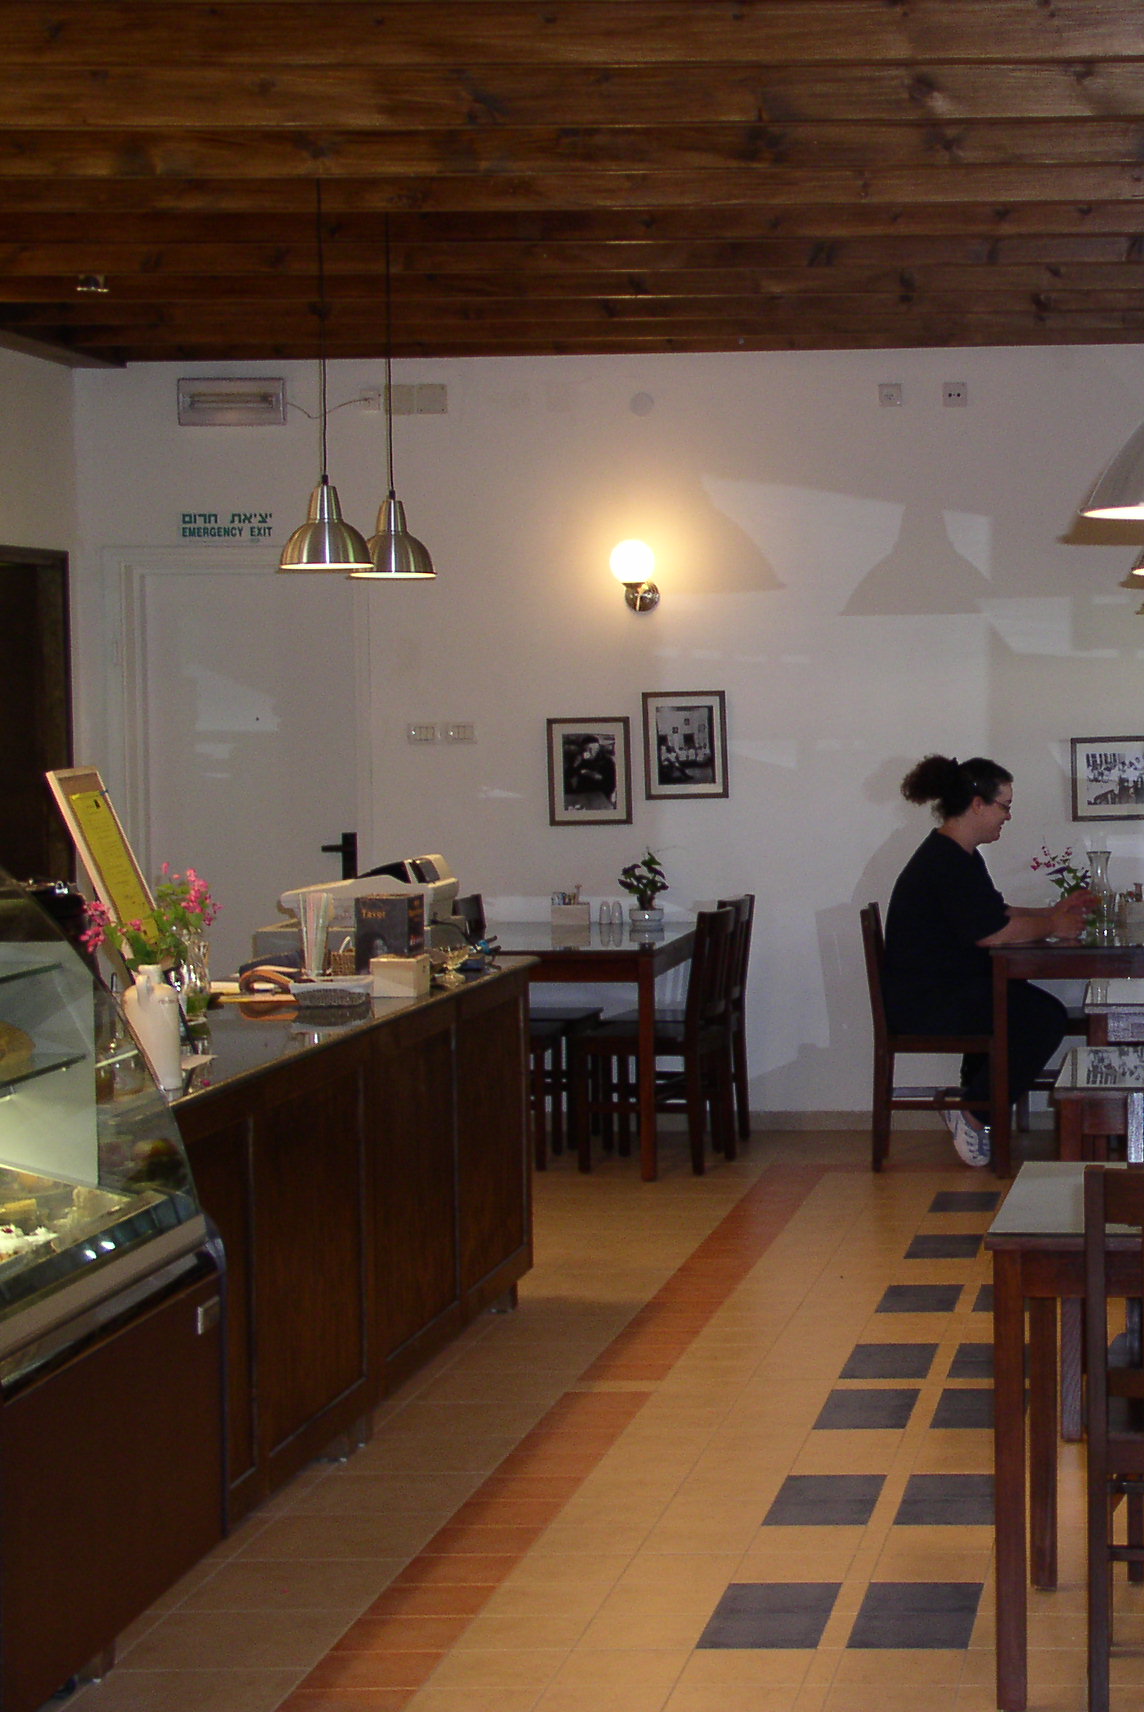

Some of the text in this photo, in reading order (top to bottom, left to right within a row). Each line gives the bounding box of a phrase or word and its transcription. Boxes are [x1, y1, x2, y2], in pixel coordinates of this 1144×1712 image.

[181, 512, 273, 524] יציאת חרום
[181, 526, 273, 538] EMERGENCY EXIT
